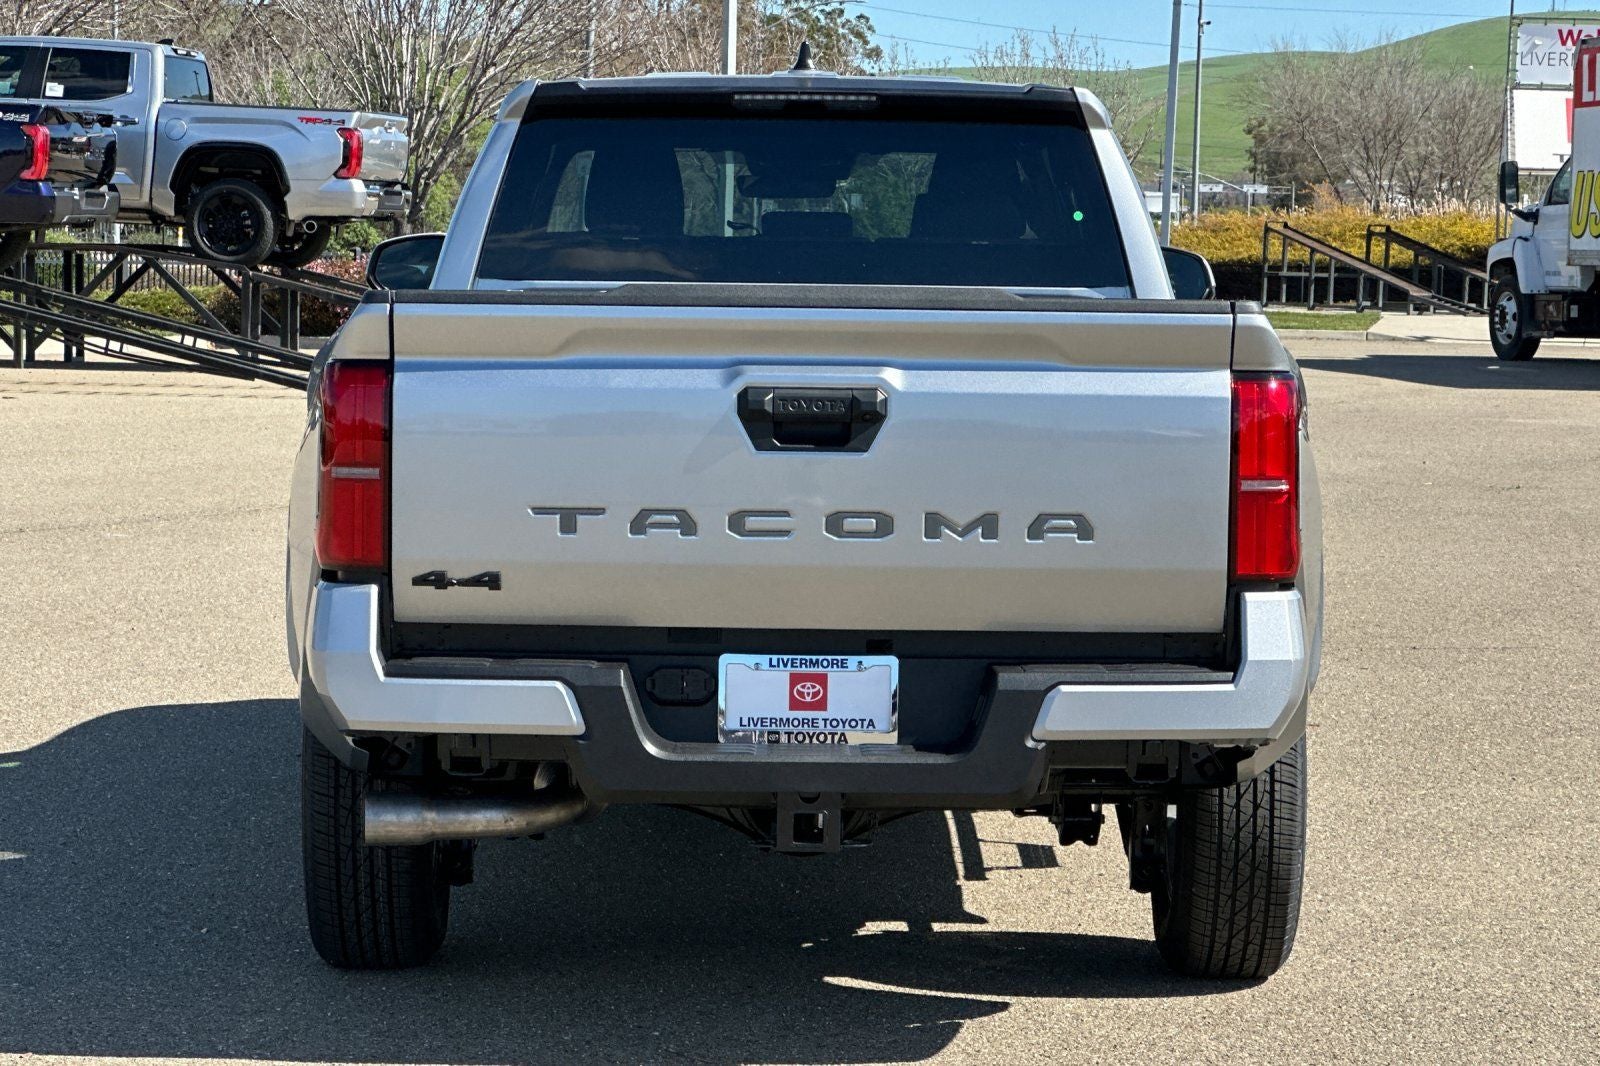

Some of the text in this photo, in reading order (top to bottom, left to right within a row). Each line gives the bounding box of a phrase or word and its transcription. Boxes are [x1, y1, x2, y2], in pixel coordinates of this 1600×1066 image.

[1520, 51, 1575, 67] LIVER
[777, 399, 846, 413] TOYOTA
[528, 507, 1095, 543] TACOMA
[768, 657, 849, 669] LIVERMORE
[739, 716, 876, 729] LIVERMORE TOYOTA
[784, 731, 849, 744] TOYOTA
